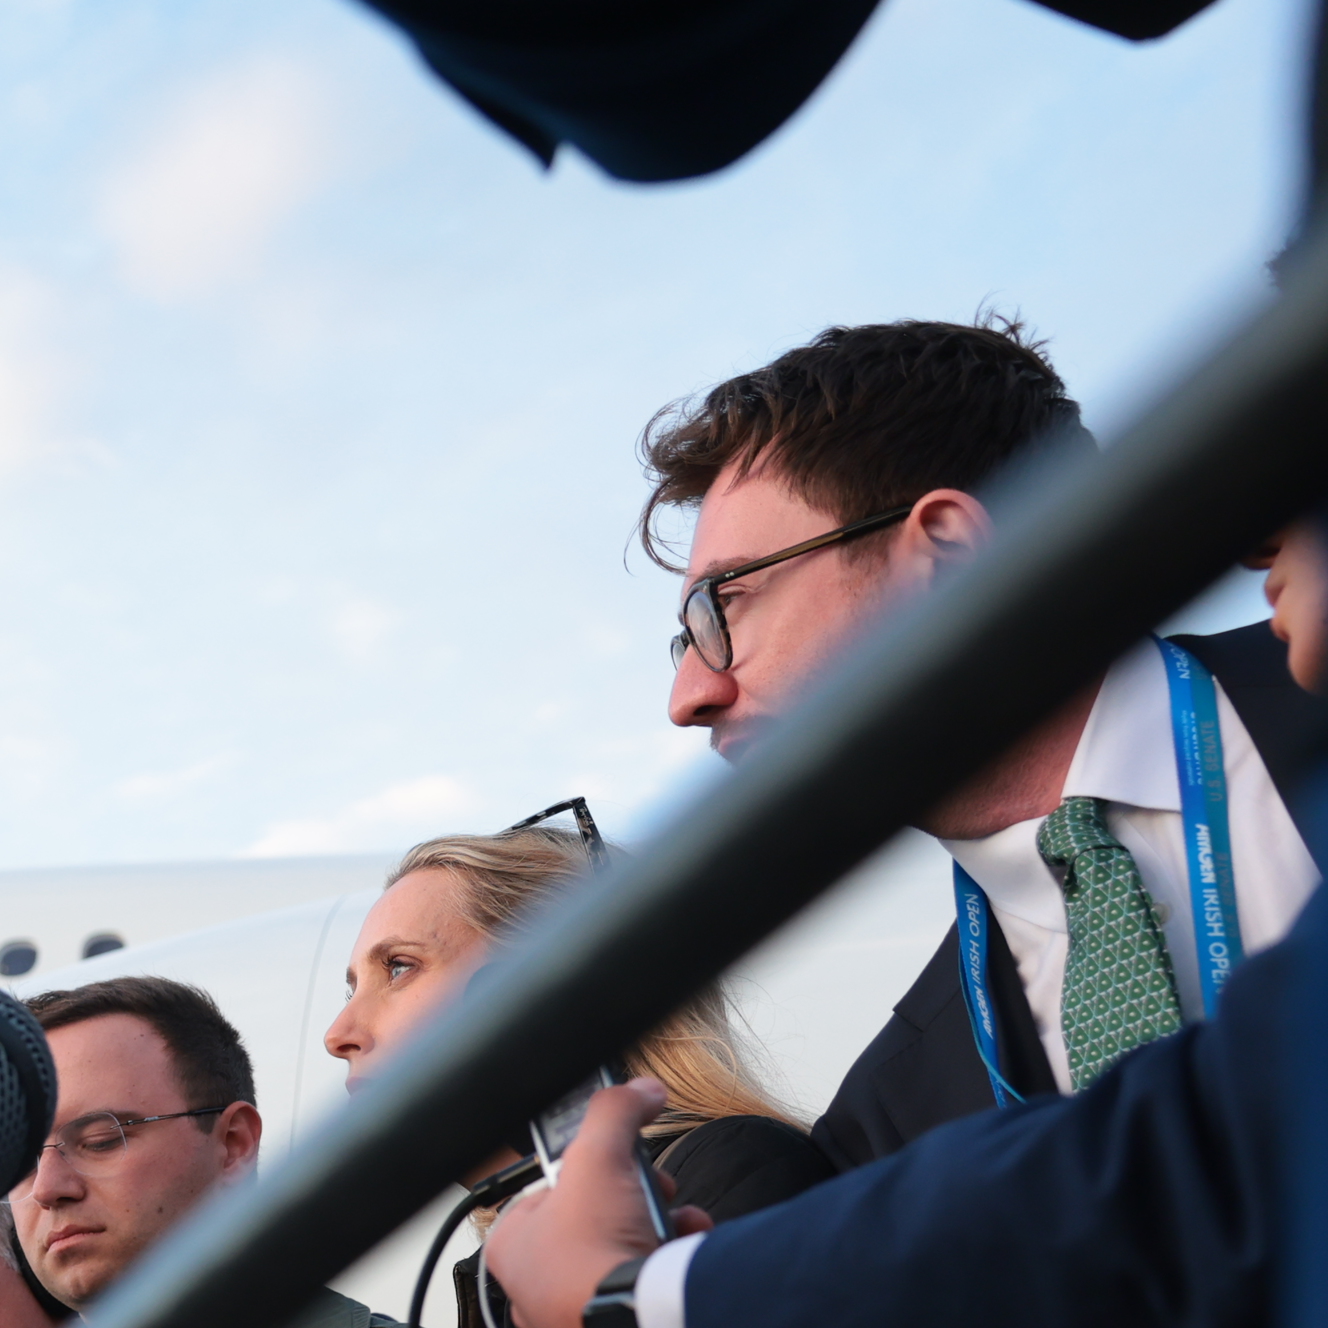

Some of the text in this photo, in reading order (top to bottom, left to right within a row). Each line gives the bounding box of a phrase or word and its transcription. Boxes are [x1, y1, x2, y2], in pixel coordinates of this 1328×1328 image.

[964, 893, 994, 1040] AMGEN IRISH OPEN
[1208, 942, 1232, 994] OPE
